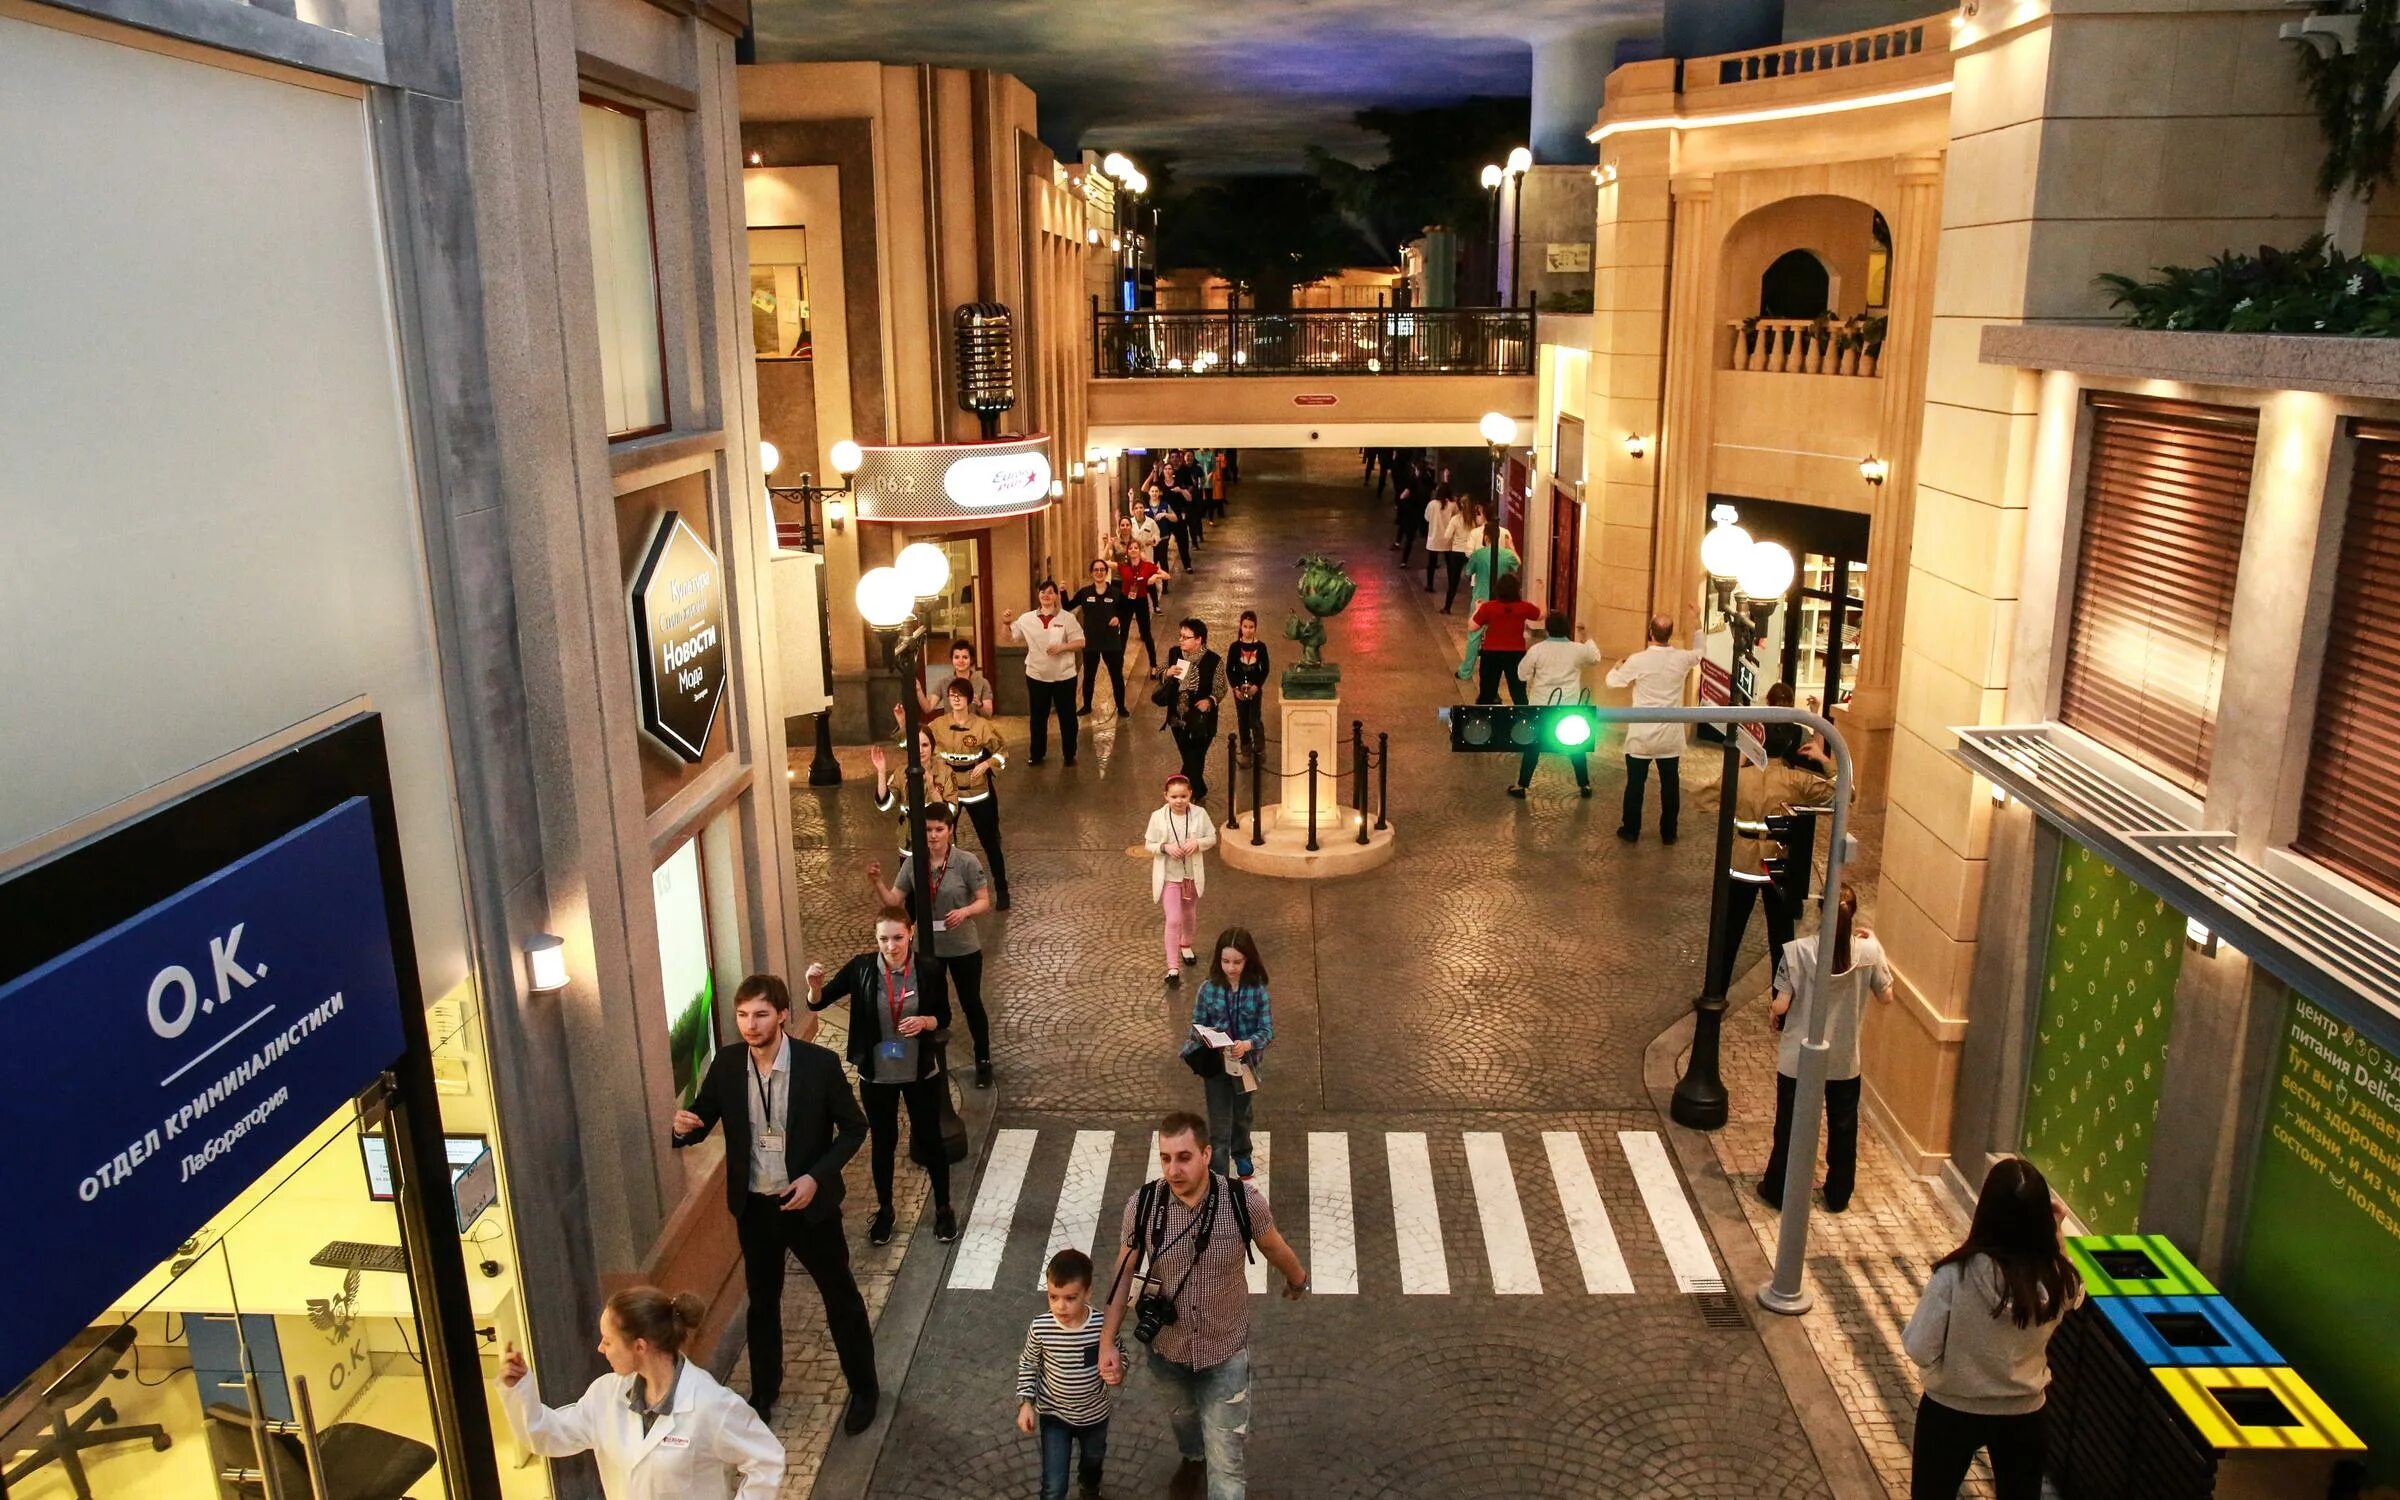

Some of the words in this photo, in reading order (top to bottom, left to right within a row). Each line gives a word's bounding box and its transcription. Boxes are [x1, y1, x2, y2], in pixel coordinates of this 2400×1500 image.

[671, 571, 710, 602] Культура
[663, 624, 716, 675] Новости
[679, 666, 703, 694] Мода
[147, 922, 268, 1039] О.К.
[2296, 999, 2339, 1040] центр
[2288, 1043, 2310, 1074] Тут
[2312, 1069, 2333, 1092] вы
[2291, 1023, 2351, 1076] питания
[79, 1128, 161, 1202] ОТДЕЛ
[164, 991, 344, 1141] КРИМИНАЛИСТИКИ
[2281, 1075, 2321, 1113] вести
[181, 1086, 289, 1183] Лаборатория
[2272, 1123, 2327, 1174] состоит
[2294, 1112, 2344, 1164] жизни,
[2348, 1156, 2361, 1174] и
[2363, 1168, 2382, 1191] из
